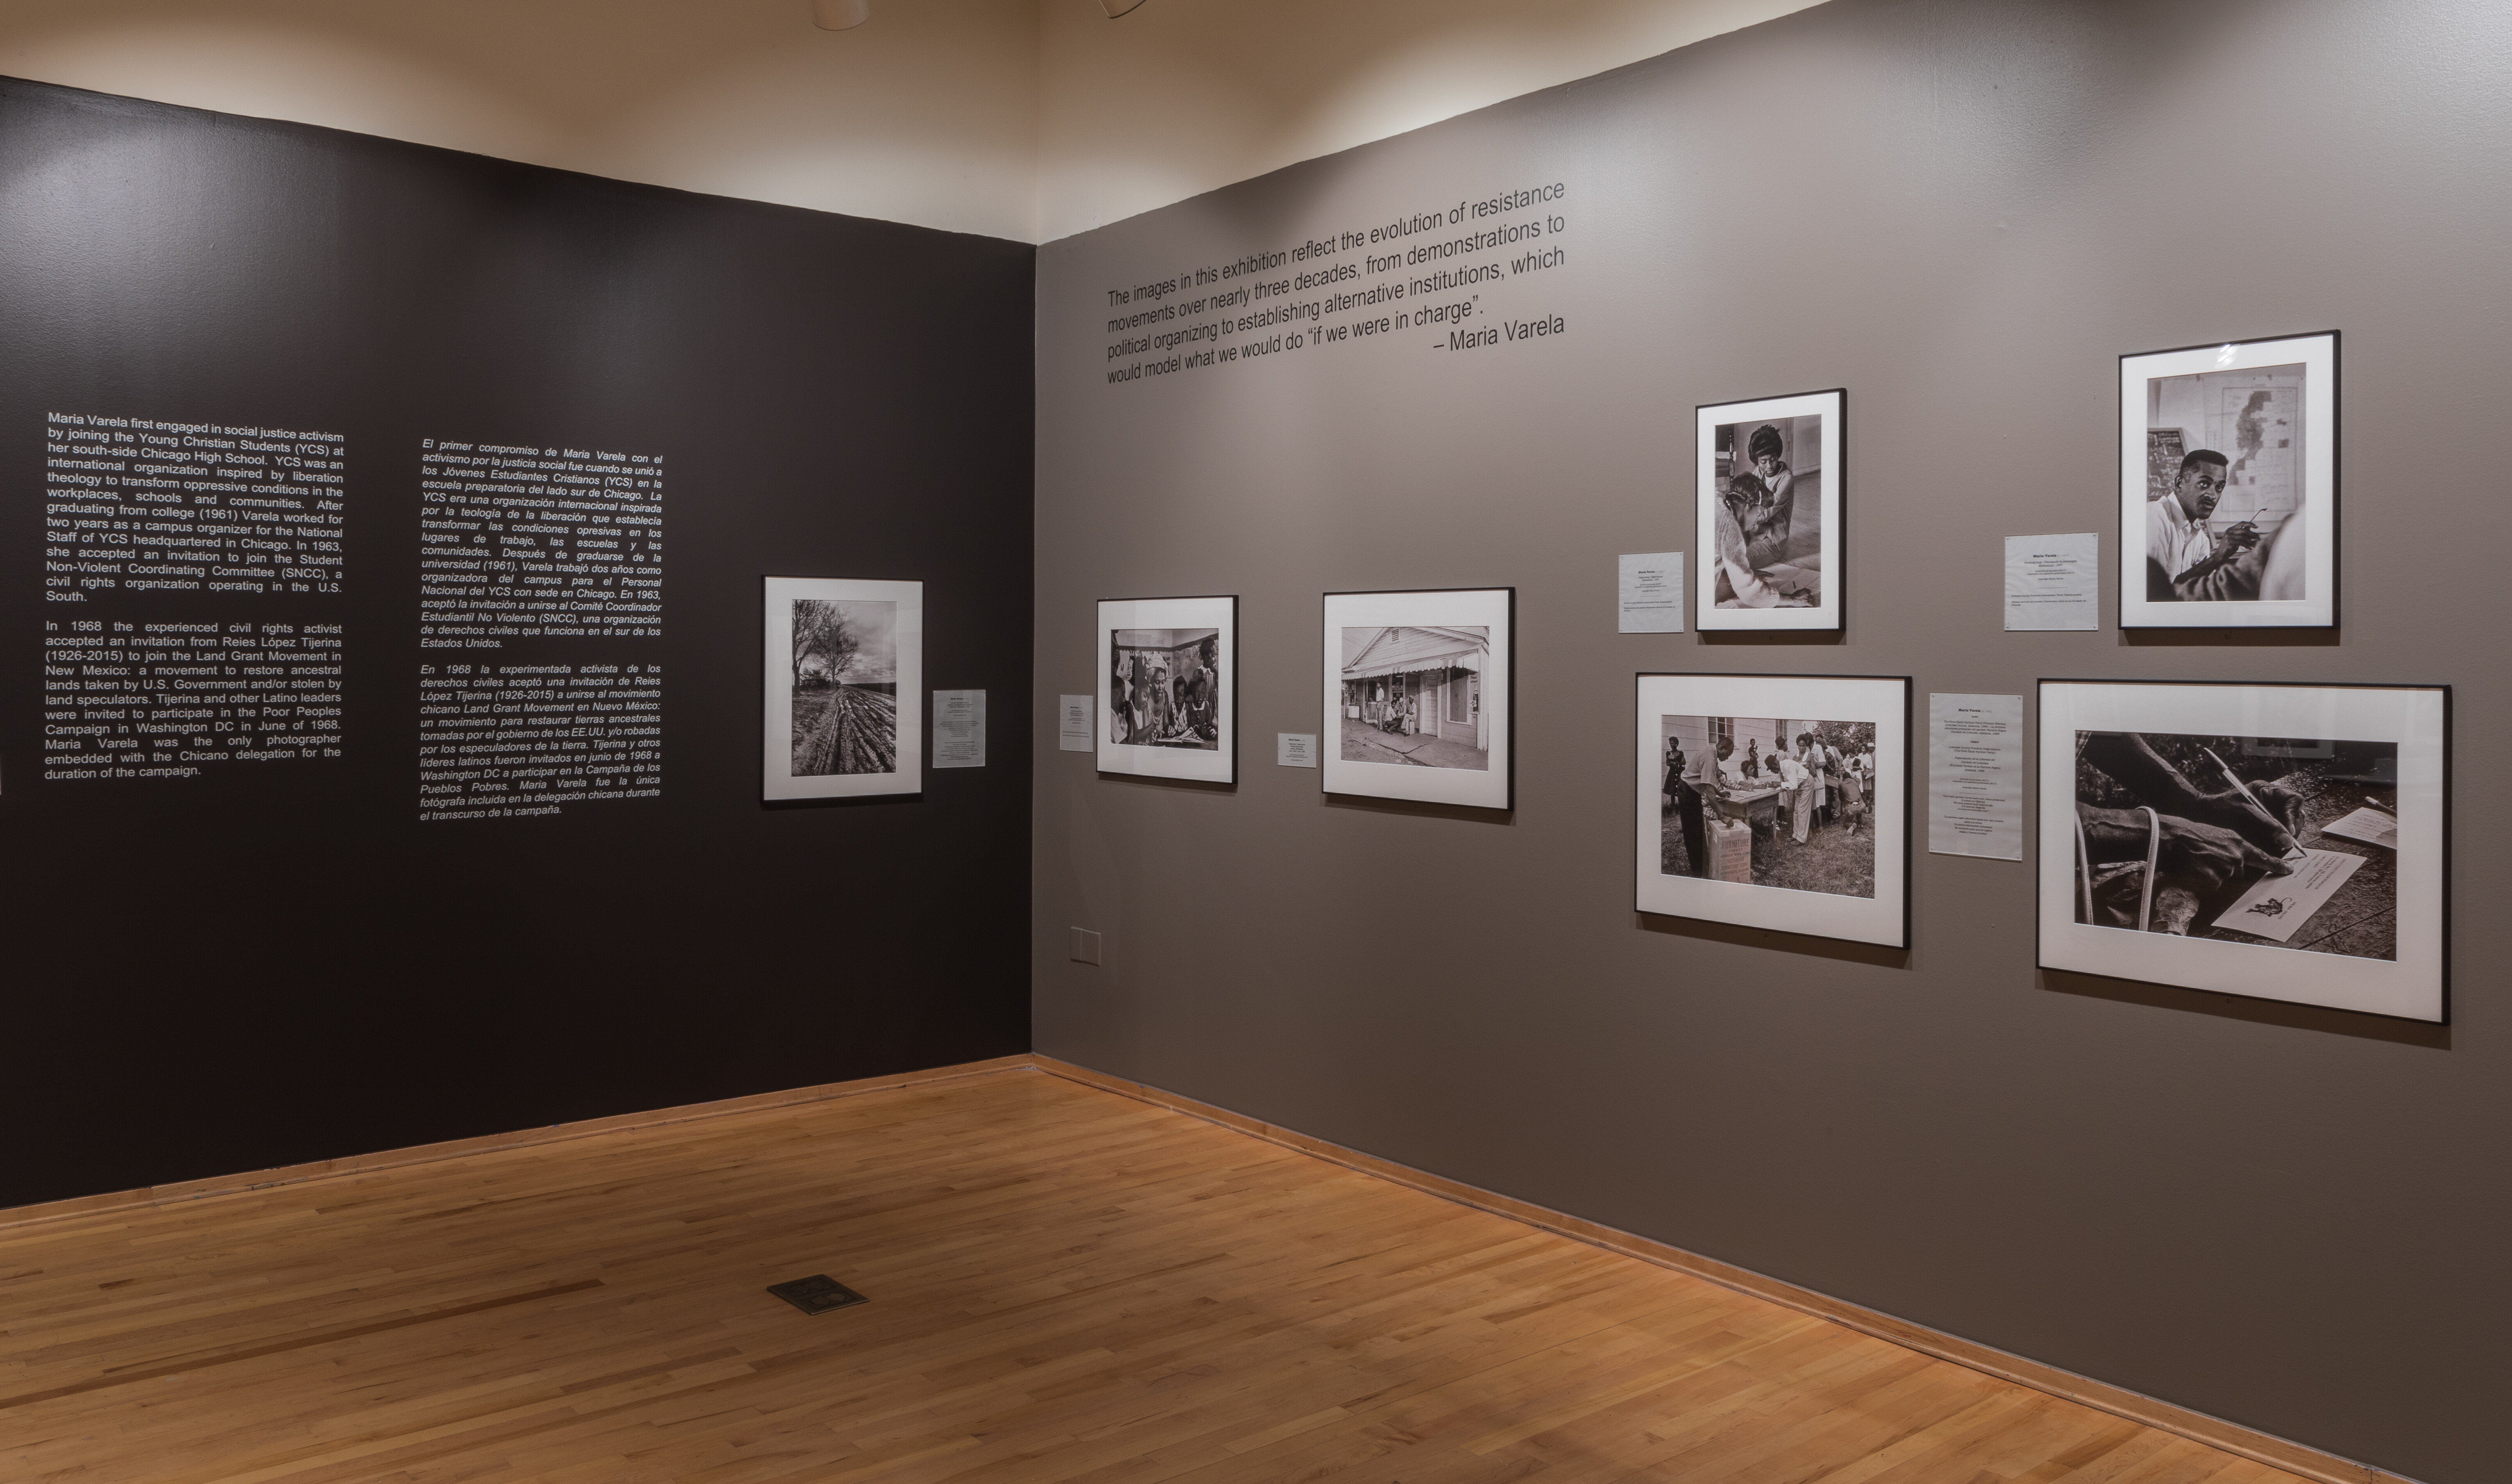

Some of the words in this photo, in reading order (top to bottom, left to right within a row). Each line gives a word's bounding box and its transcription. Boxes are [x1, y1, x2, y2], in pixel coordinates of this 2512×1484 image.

[1107, 289, 1130, 307] The
[1133, 279, 1176, 302] images
[1181, 275, 1191, 290] in
[1195, 268, 1218, 286] this
[1222, 251, 1286, 280] exhibition
[1292, 235, 1336, 263] reflect
[1340, 230, 1365, 251] the
[1370, 212, 1442, 244] evolution
[1449, 201, 1466, 225] of
[1471, 182, 1565, 220] resistance
[1108, 304, 1175, 333] movements
[1178, 298, 1207, 317] over
[1210, 285, 1251, 310] nearly
[1254, 279, 1290, 300] three
[1294, 263, 1361, 291] decades,
[1366, 253, 1402, 275] from
[1407, 221, 1541, 266] demonstrations
[1546, 214, 1565, 234] to
[1108, 333, 1151, 363] political
[1154, 323, 1218, 351] organizing
[1221, 318, 1234, 335] to
[1238, 301, 1320, 332] establishing
[1324, 284, 1404, 314] alternative
[1409, 263, 1505, 296] institutions,
[1510, 245, 1564, 275] which
[1450, 328, 1498, 352] Maria
[1504, 313, 1564, 342] Varela
[1107, 362, 1141, 384] would
[1145, 353, 1181, 378] model
[1184, 348, 1215, 369] what
[1218, 347, 1238, 363] we
[1241, 333, 1281, 359] would
[1285, 331, 1304, 351] do
[1325, 326, 1347, 343] we
[1352, 317, 1390, 338] were
[1395, 313, 1409, 331] in
[48, 412, 84, 424] Maria
[87, 415, 128, 427] Varela
[130, 417, 154, 429] first
[155, 422, 208, 434] engaged
[211, 424, 222, 434] in
[224, 426, 258, 436] social
[259, 427, 297, 439] justice
[299, 431, 344, 442] activism
[422, 438, 434, 448] El
[439, 440, 473, 451] primer
[479, 445, 539, 456] compromiso
[545, 447, 557, 456] de
[563, 448, 590, 459] Maria
[596, 451, 626, 461] Varela
[654, 455, 663, 464] el
[48, 457, 125, 471] international
[134, 464, 208, 476] organization
[217, 467, 262, 479] inspired
[271, 470, 285, 482] by
[293, 471, 343, 483] liberation
[47, 502, 114, 517] graduating
[119, 504, 147, 515] from
[152, 507, 195, 520] college
[199, 508, 238, 522] (1961)
[242, 510, 279, 521] Varela
[283, 513, 324, 523] worked
[328, 514, 344, 524] for
[423, 492, 446, 502] YCS
[493, 497, 555, 508] organización
[558, 499, 618, 511] internacional
[620, 502, 662, 514] inspirada
[421, 546, 491, 556] comunidades.
[502, 548, 546, 560] Después
[555, 550, 568, 559] de
[576, 552, 624, 562] graduarse
[633, 553, 644, 562] de
[653, 554, 662, 562] la
[47, 561, 121, 573] Non-Violent
[128, 563, 205, 577] Coordinating
[212, 565, 275, 577] Committee
[282, 568, 328, 581] (SNCC),
[421, 612, 475, 622] Estudiantil
[477, 613, 492, 622] No
[496, 613, 536, 622] Violento
[539, 613, 578, 625] (SNCC),
[603, 615, 661, 625] organización
[46, 636, 103, 648] accepted
[131, 636, 185, 646] invitation
[190, 636, 217, 646] from
[223, 637, 256, 647] Reies
[261, 637, 296, 649] López
[301, 637, 342, 649] Tijerina
[420, 691, 452, 702] López
[456, 691, 492, 702] Tijerina
[495, 690, 554, 702] (1926-2015)
[597, 689, 607, 698] al
[608, 689, 661, 698] movimiento
[45, 739, 81, 750] Maria
[98, 738, 138, 748] Varela
[154, 739, 178, 747] was
[194, 736, 212, 746] the
[228, 735, 252, 748] only
[267, 734, 342, 747] photographer
[420, 796, 466, 809] fotógrafa
[468, 795, 506, 805] incluida
[523, 793, 532, 802] la
[534, 791, 586, 803] delegación
[588, 790, 624, 799] chicana
[626, 788, 660, 797] durante
[1722, 839, 1749, 850] FURNITURE
